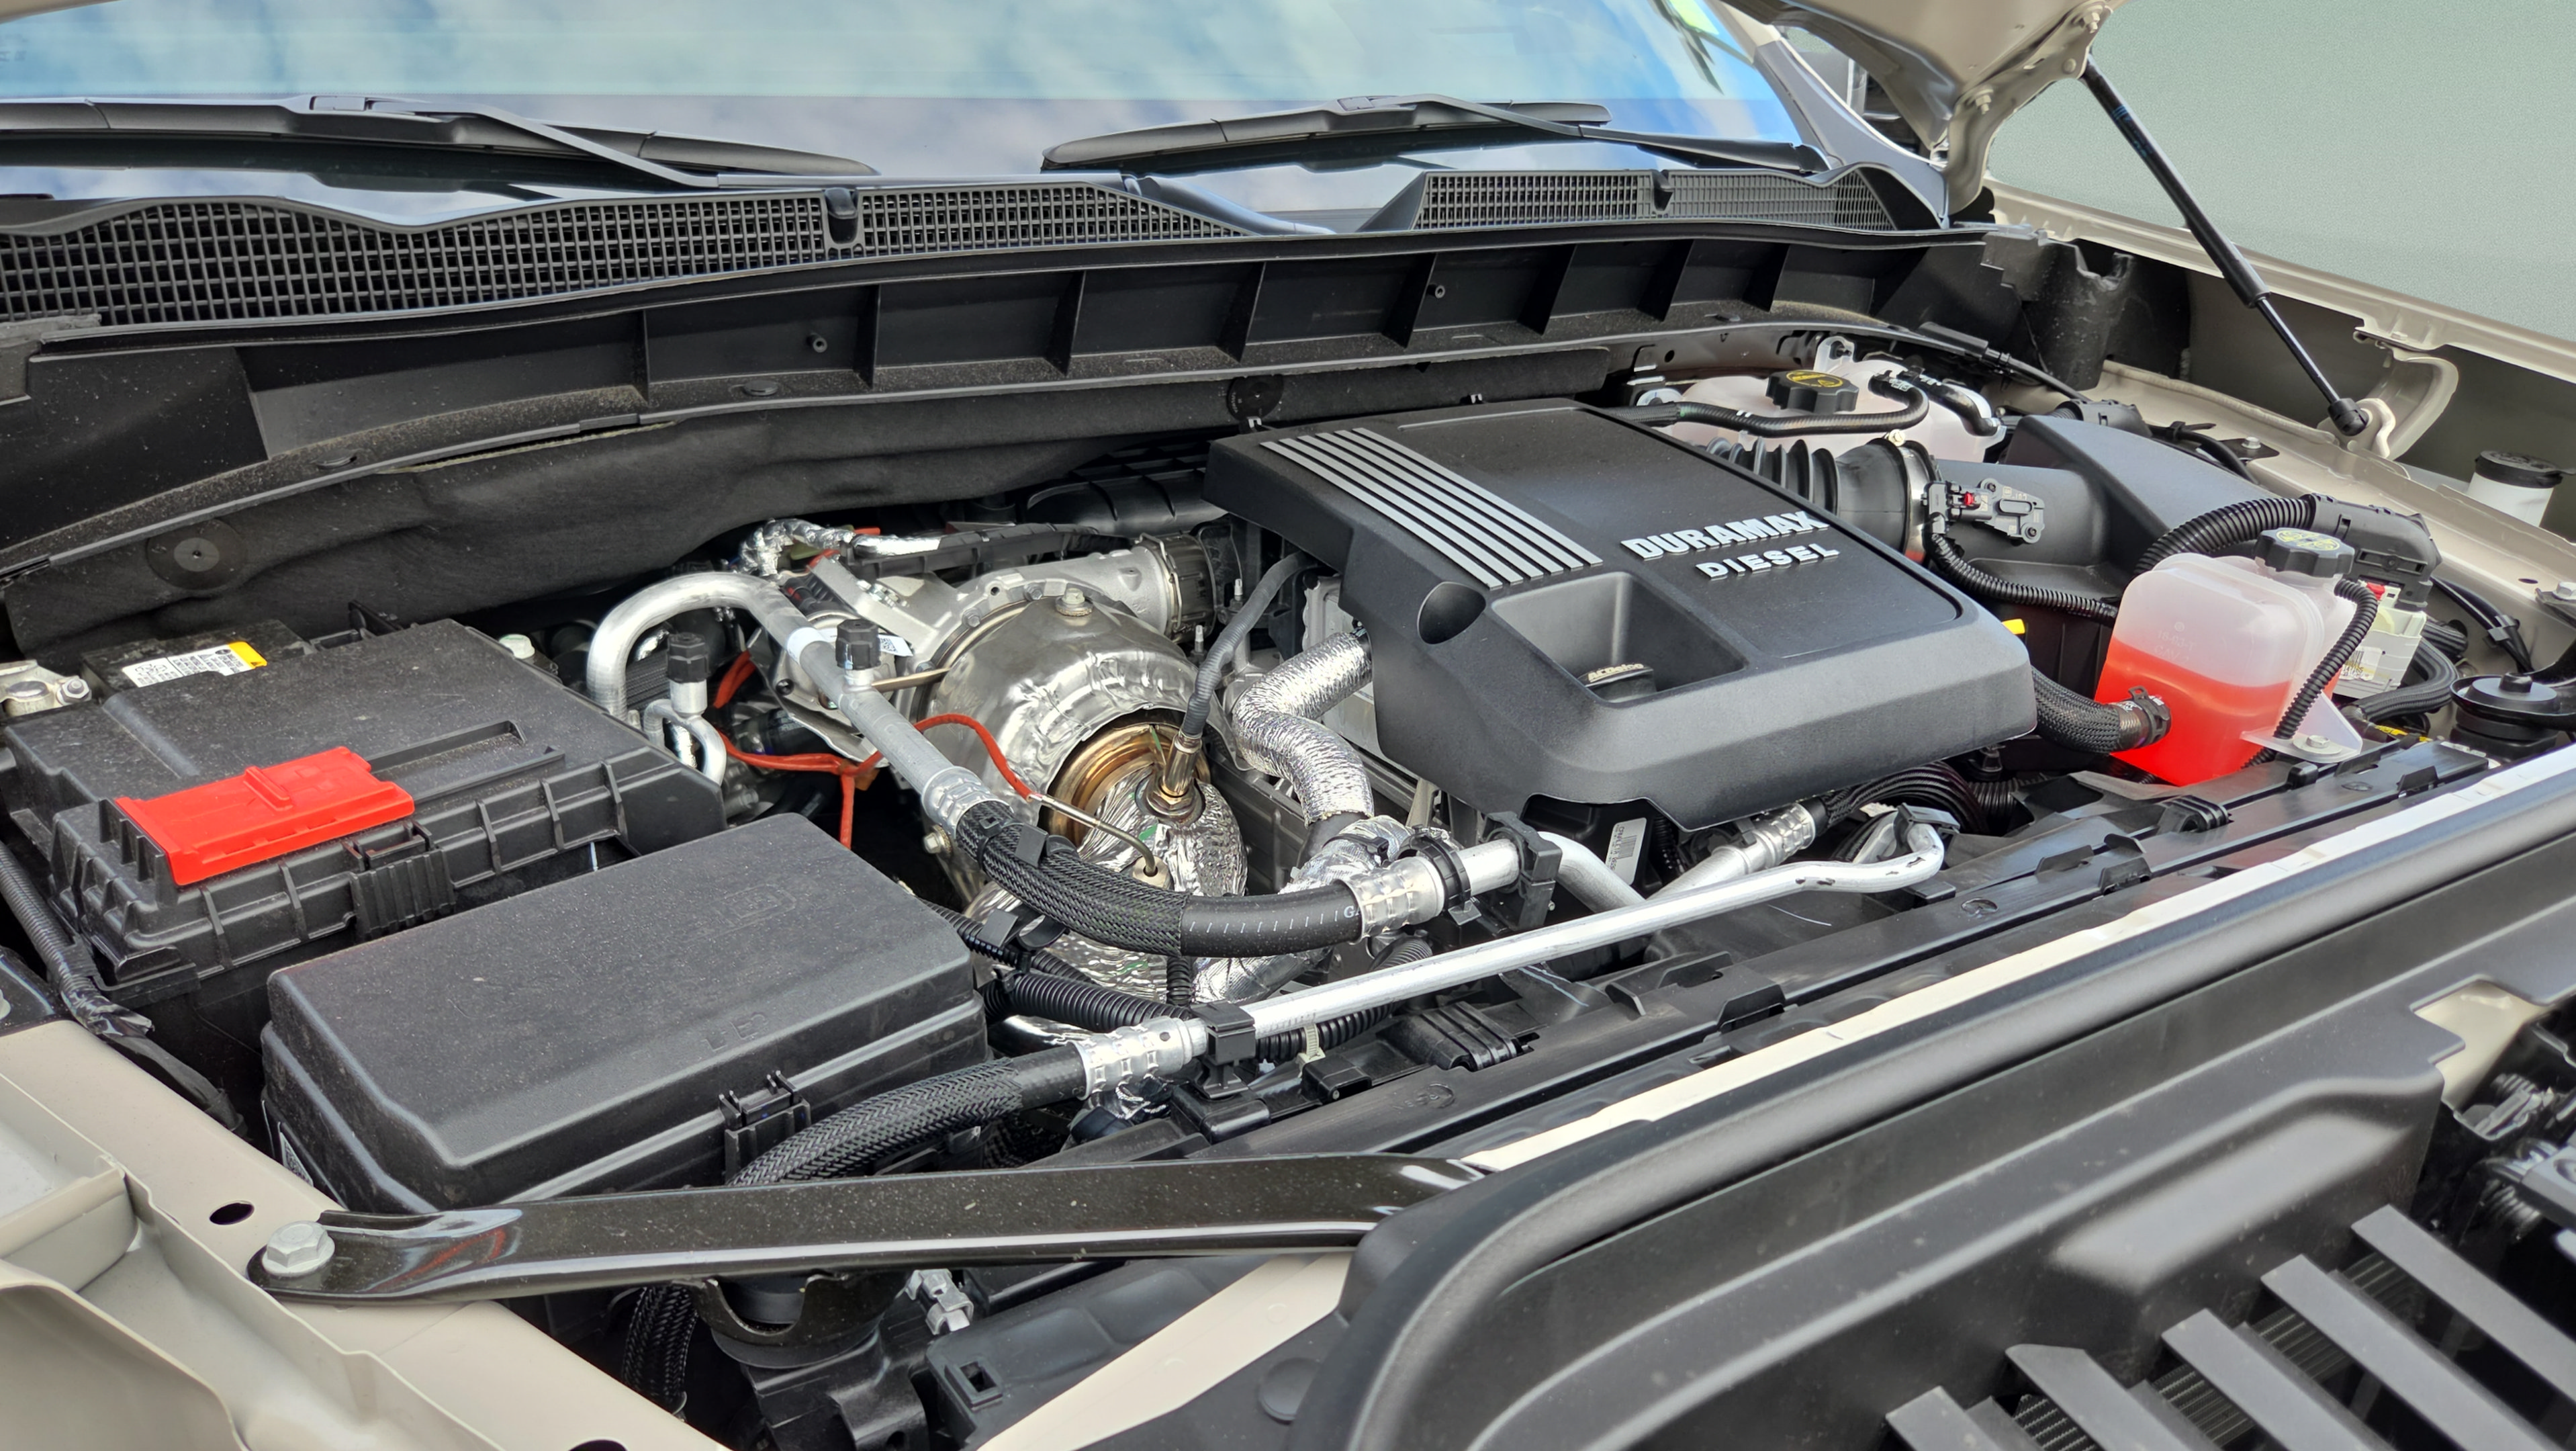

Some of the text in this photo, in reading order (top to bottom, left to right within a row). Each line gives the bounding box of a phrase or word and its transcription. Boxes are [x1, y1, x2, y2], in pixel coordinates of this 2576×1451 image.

[1620, 511, 1830, 560] DURAMAX
[1696, 543, 1840, 580] DIESEL
[1588, 663, 1644, 682] ACDelco
